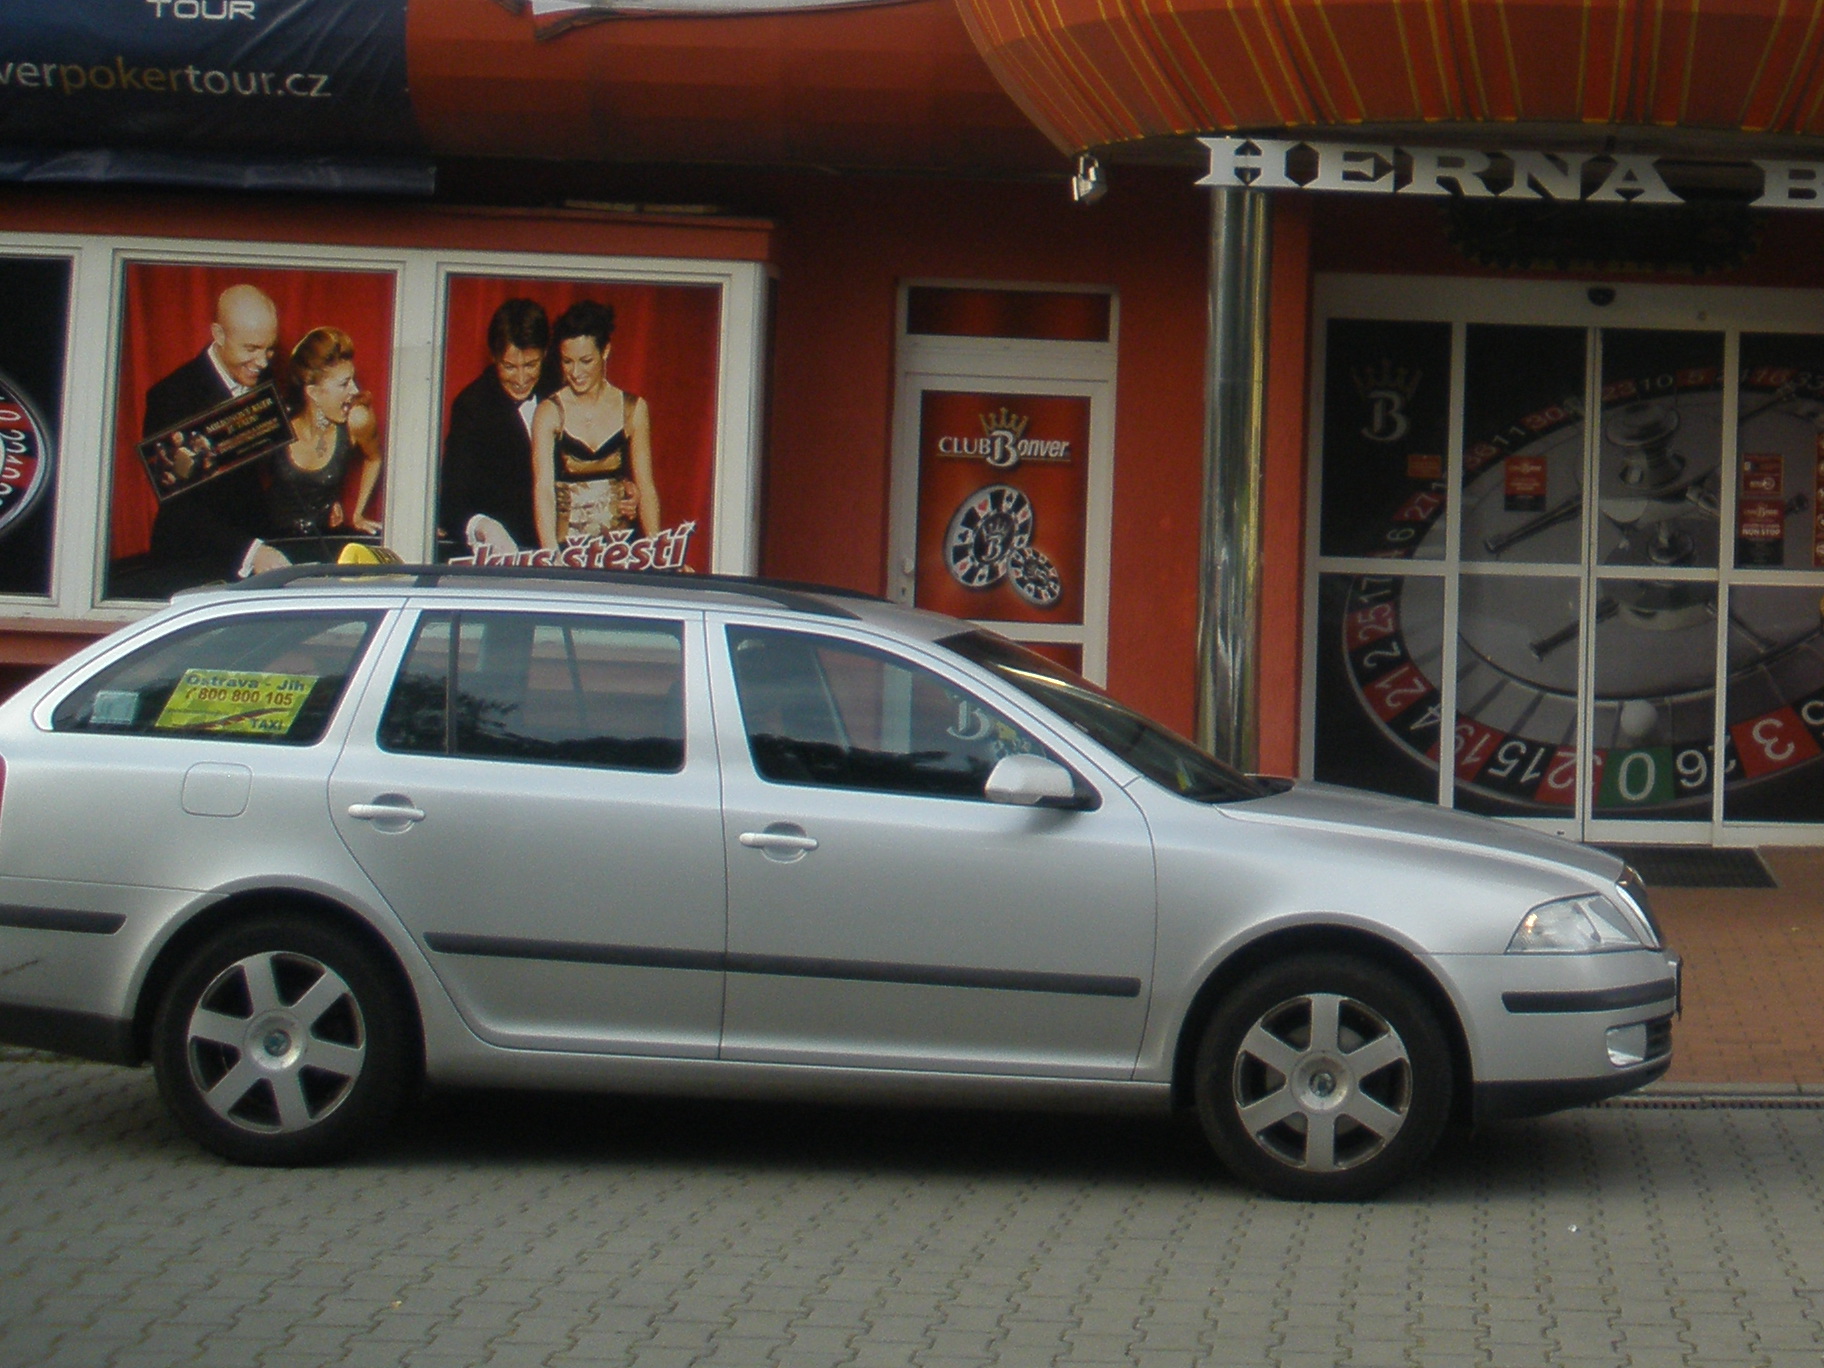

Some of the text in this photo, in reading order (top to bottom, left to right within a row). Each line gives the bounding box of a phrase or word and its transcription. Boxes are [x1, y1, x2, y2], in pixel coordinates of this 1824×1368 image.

[1194, 136, 1687, 204] HERNA
[938, 430, 1071, 468] CLUB Bonver
[562, 521, 696, 572] štěstí
[186, 674, 259, 688] Ostrava
[199, 687, 293, 706] 800 800 105
[250, 718, 283, 731] TAXI
[1752, 718, 1796, 761] 3
[1488, 740, 1546, 783] 15
[1618, 752, 1656, 801] 0
